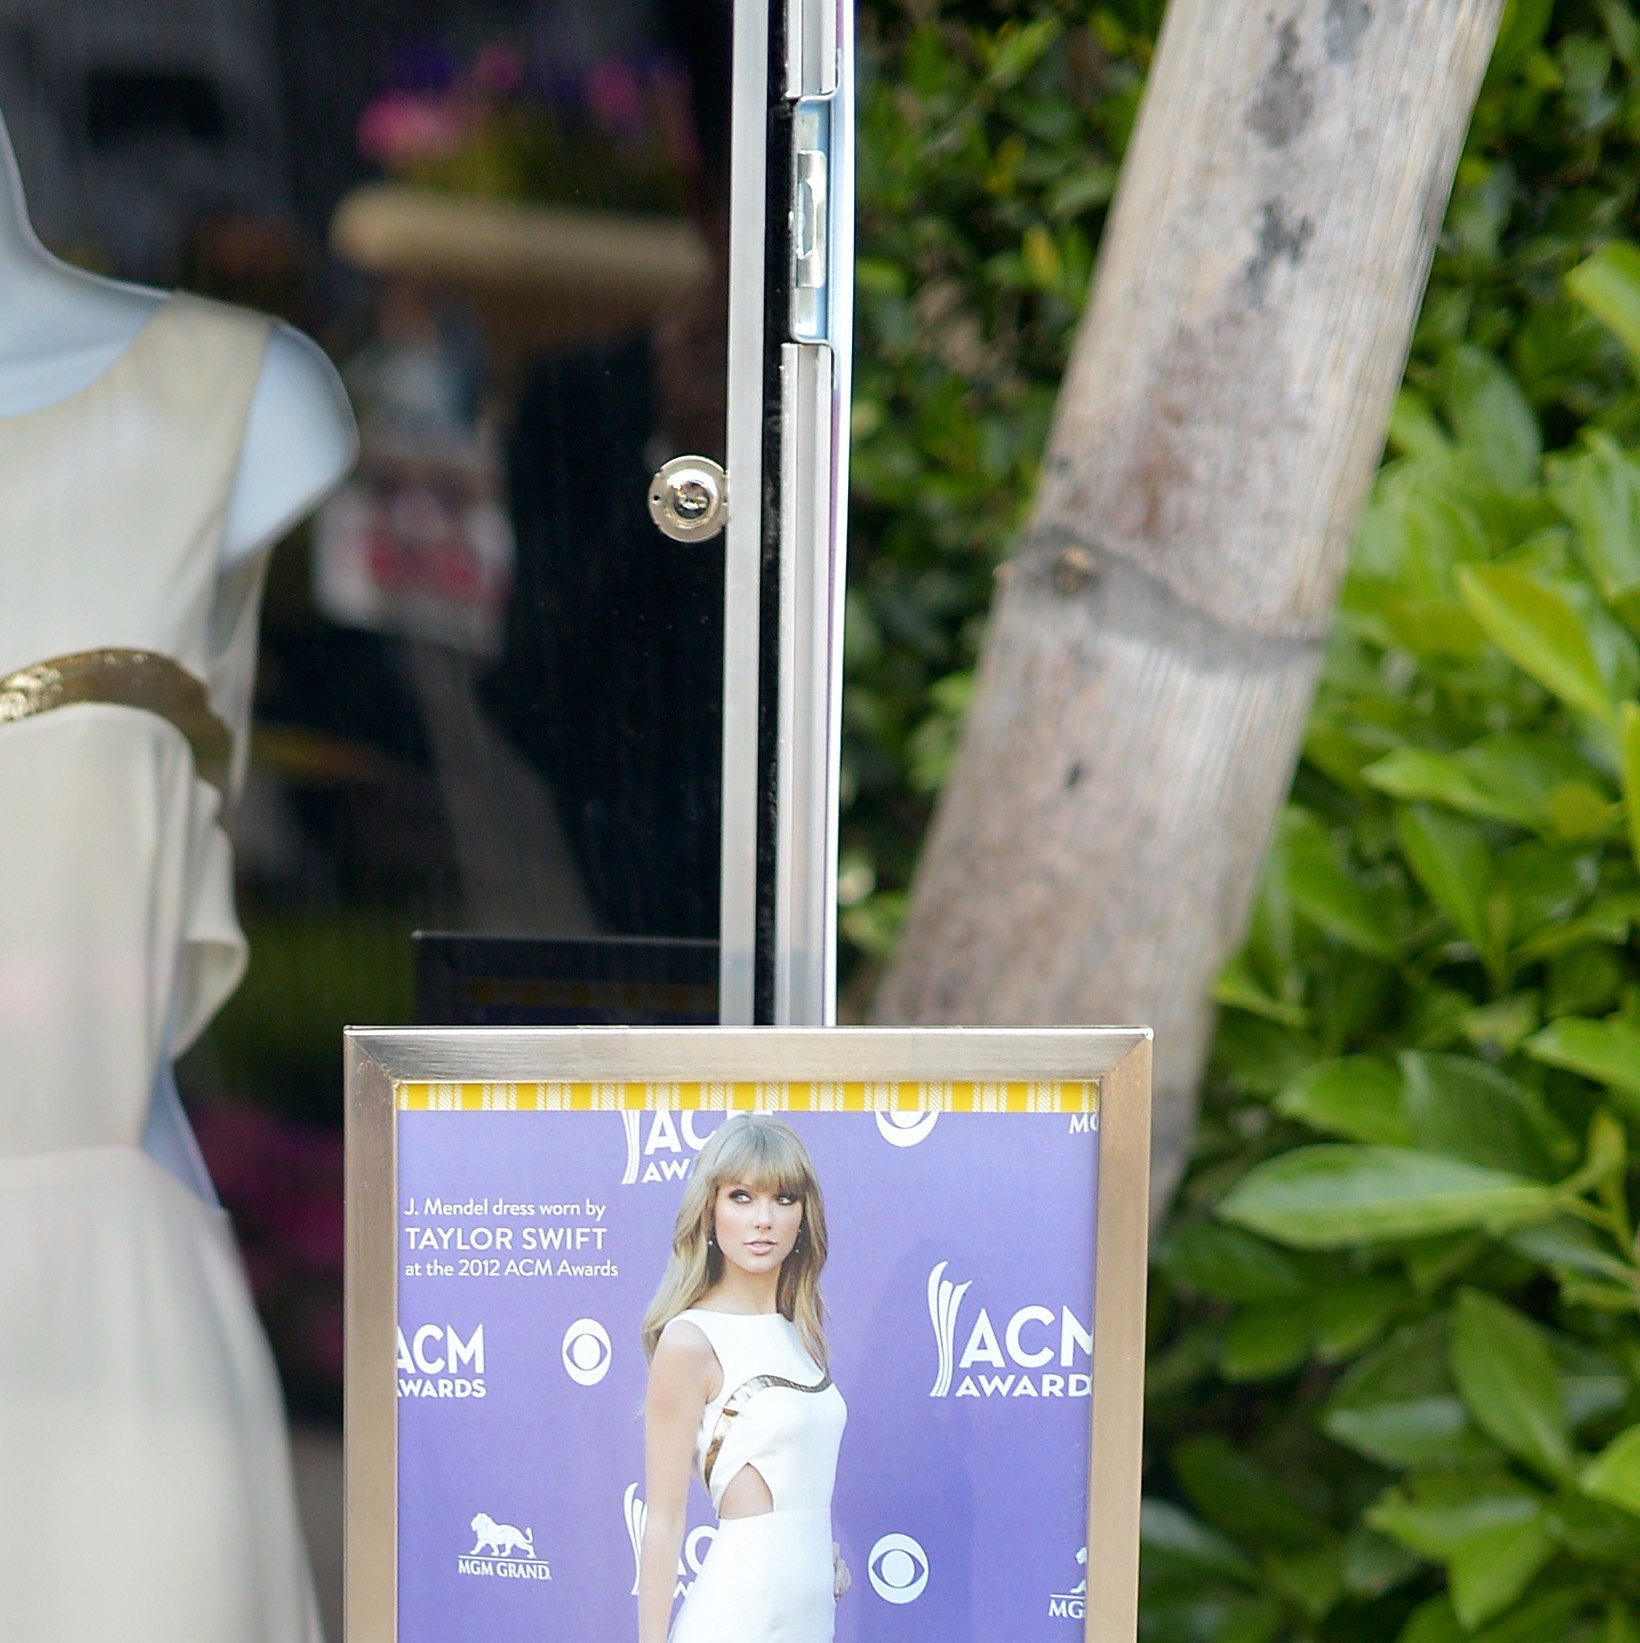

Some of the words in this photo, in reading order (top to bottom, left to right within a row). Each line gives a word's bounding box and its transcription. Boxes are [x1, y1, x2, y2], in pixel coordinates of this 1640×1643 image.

[644, 1110, 746, 1155] AC
[403, 1199, 419, 1216] J.
[424, 1198, 488, 1216] Mendel
[493, 1198, 535, 1216] dress
[539, 1203, 581, 1216] worn
[585, 1198, 607, 1221] by
[404, 1227, 512, 1250] TAYLOR
[521, 1227, 608, 1250] SWIFT
[404, 1261, 421, 1277] at
[425, 1259, 454, 1277] the
[458, 1259, 500, 1277] 2012
[504, 1258, 553, 1277] ACM
[556, 1258, 619, 1277] Awards
[397, 1378, 487, 1398] WARDS
[955, 1374, 1093, 1397] AWARD
[458, 1559, 494, 1576] MGM
[496, 1561, 551, 1580] GRAND
[1048, 1599, 1084, 1619] MG
